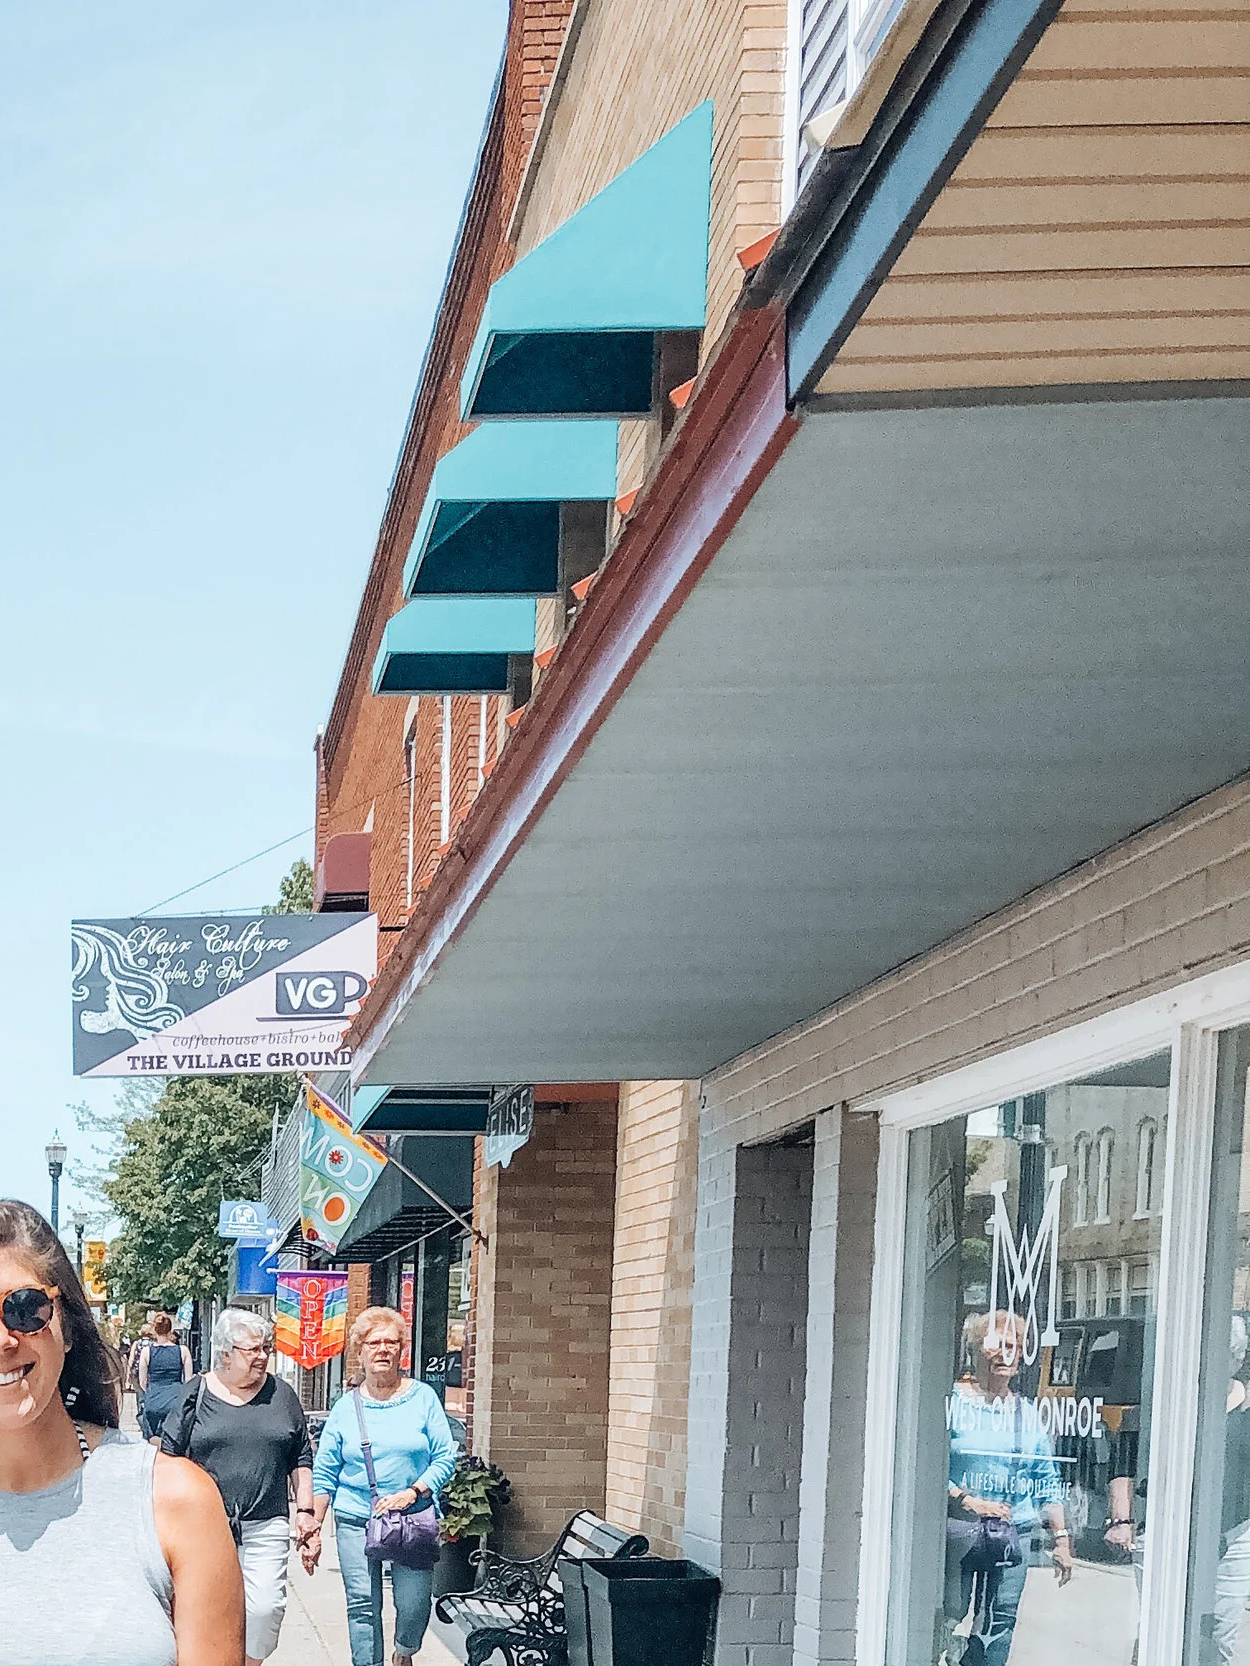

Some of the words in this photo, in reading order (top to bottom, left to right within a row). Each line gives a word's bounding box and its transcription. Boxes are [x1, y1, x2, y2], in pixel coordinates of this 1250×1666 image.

[124, 926, 193, 958] Hair
[201, 919, 291, 970] Culture
[151, 958, 191, 985] Salon
[192, 959, 213, 988] &
[216, 956, 245, 997] Spa
[127, 1055, 168, 1070] THE
[172, 1053, 262, 1070] VILLAGE
[301, 1279, 322, 1360] OPEN
[944, 1394, 986, 1431] WEST
[991, 1395, 1015, 1433] ON
[1020, 1396, 1104, 1439] MONROE
[961, 1471, 968, 1488] A
[970, 1472, 1016, 1495] LIFESTYLE
